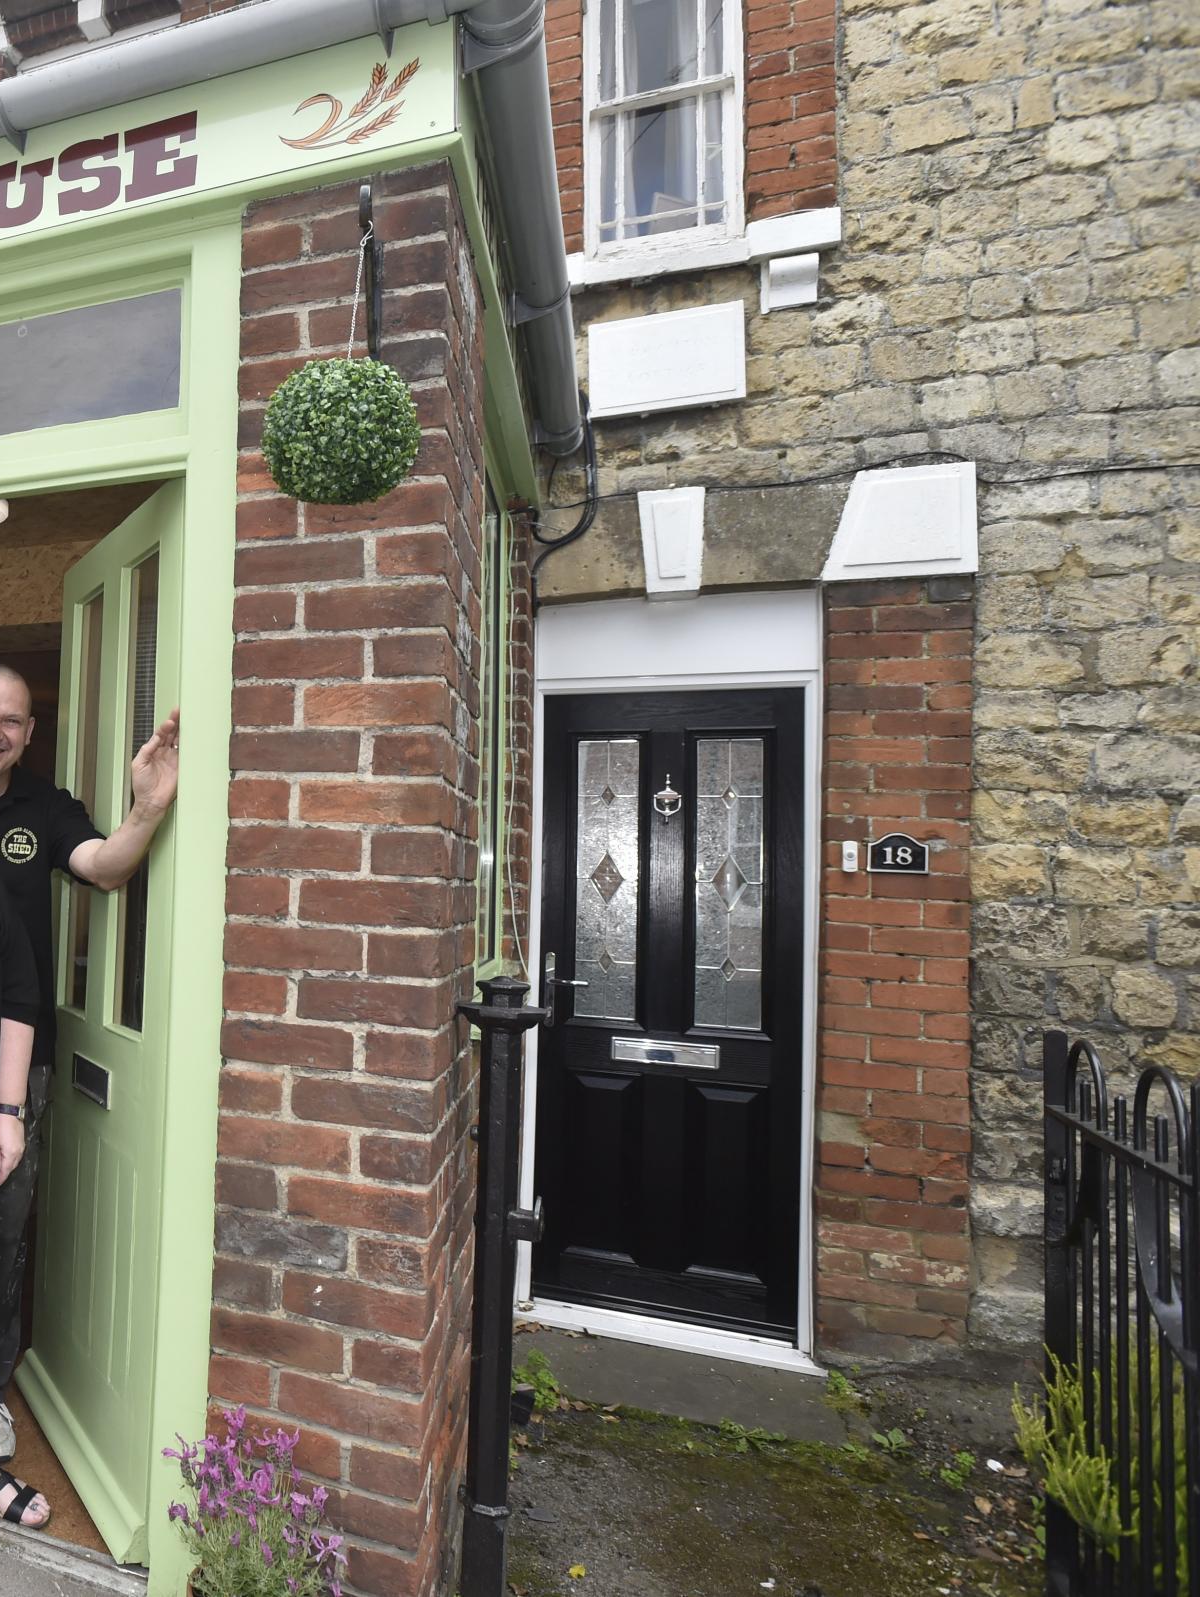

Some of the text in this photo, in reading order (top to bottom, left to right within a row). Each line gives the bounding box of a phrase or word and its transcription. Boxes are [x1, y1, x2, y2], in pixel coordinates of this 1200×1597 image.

[13, 834, 28, 844] THE
[8, 843, 32, 855] SHED
[882, 846, 913, 865] 18
